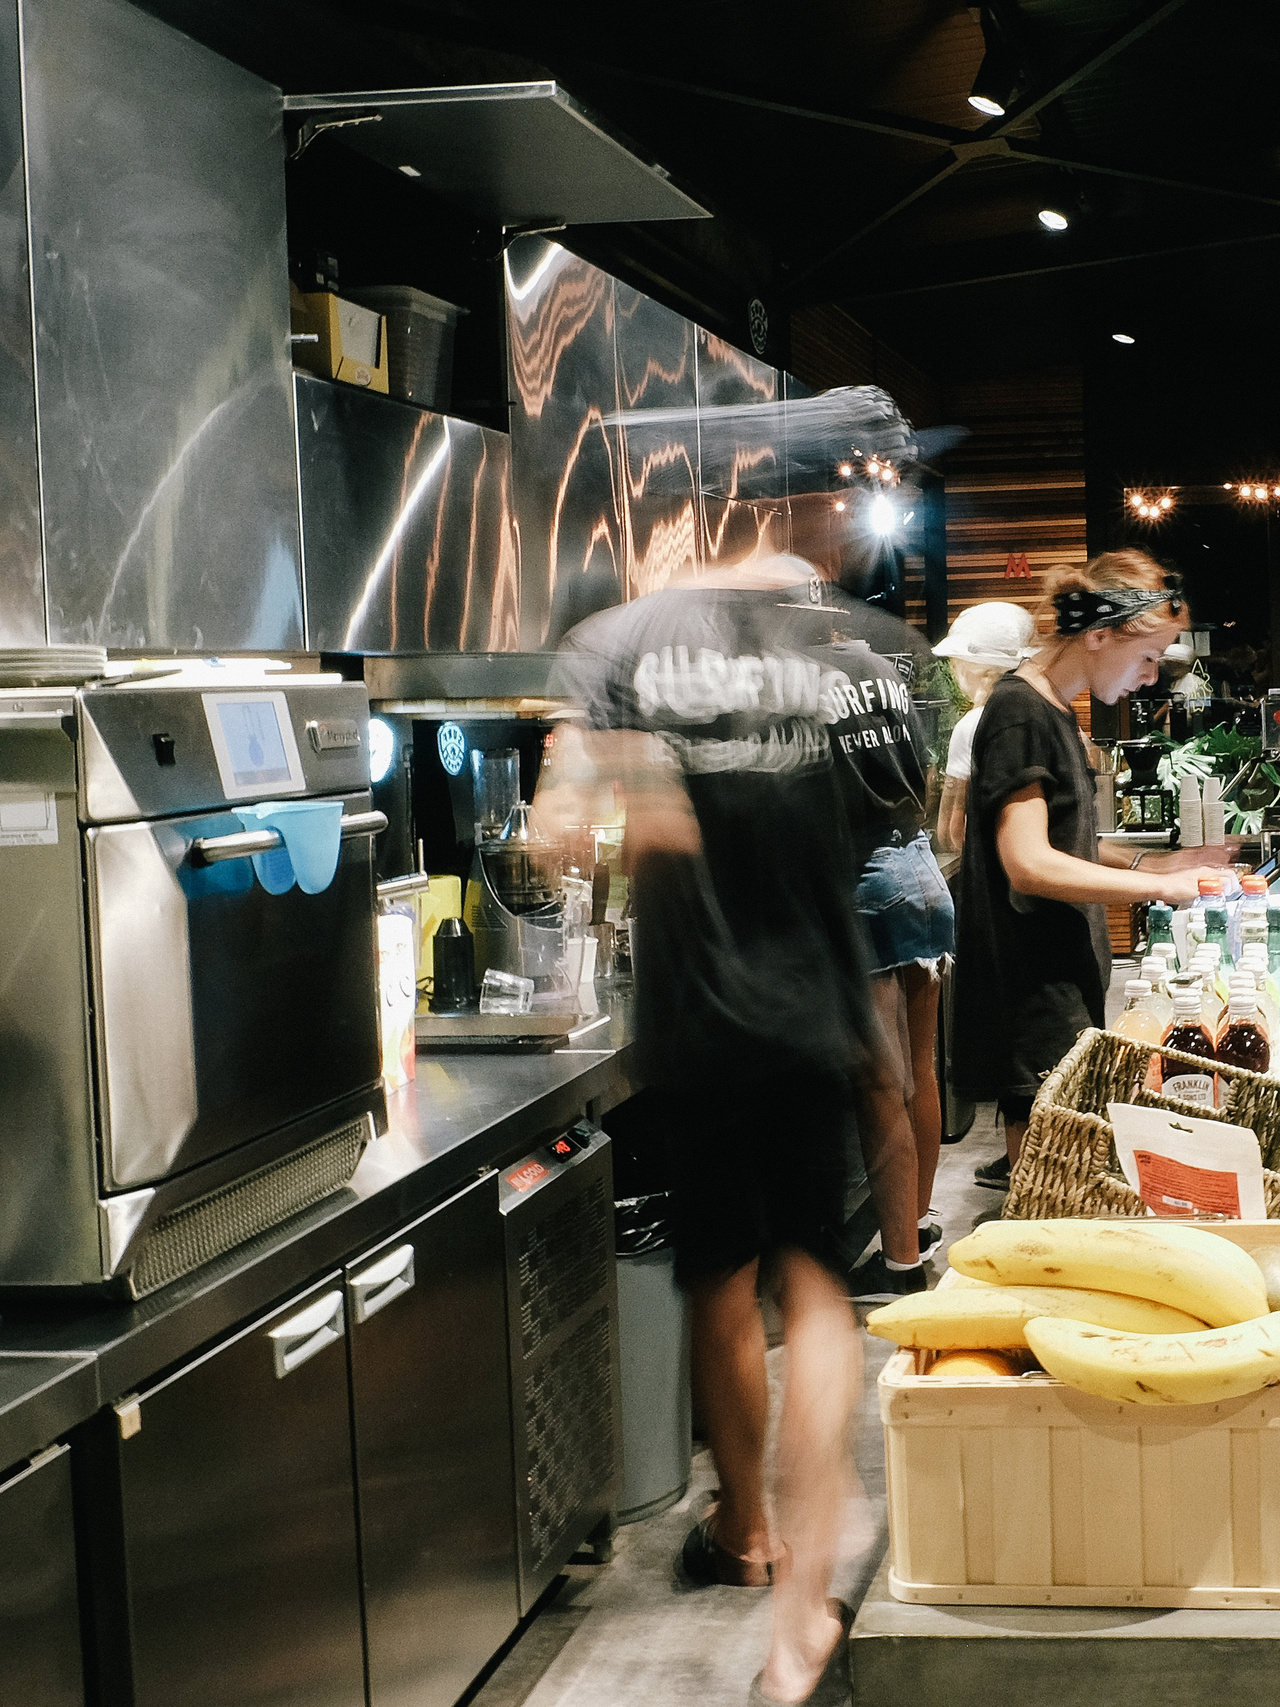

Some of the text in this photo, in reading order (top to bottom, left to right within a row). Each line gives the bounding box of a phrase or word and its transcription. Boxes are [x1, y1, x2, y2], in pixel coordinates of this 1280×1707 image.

[1004, 553, 1032, 579] M
[818, 678, 909, 725] SURFING
[1172, 1080, 1210, 1093] FRANKLIN
